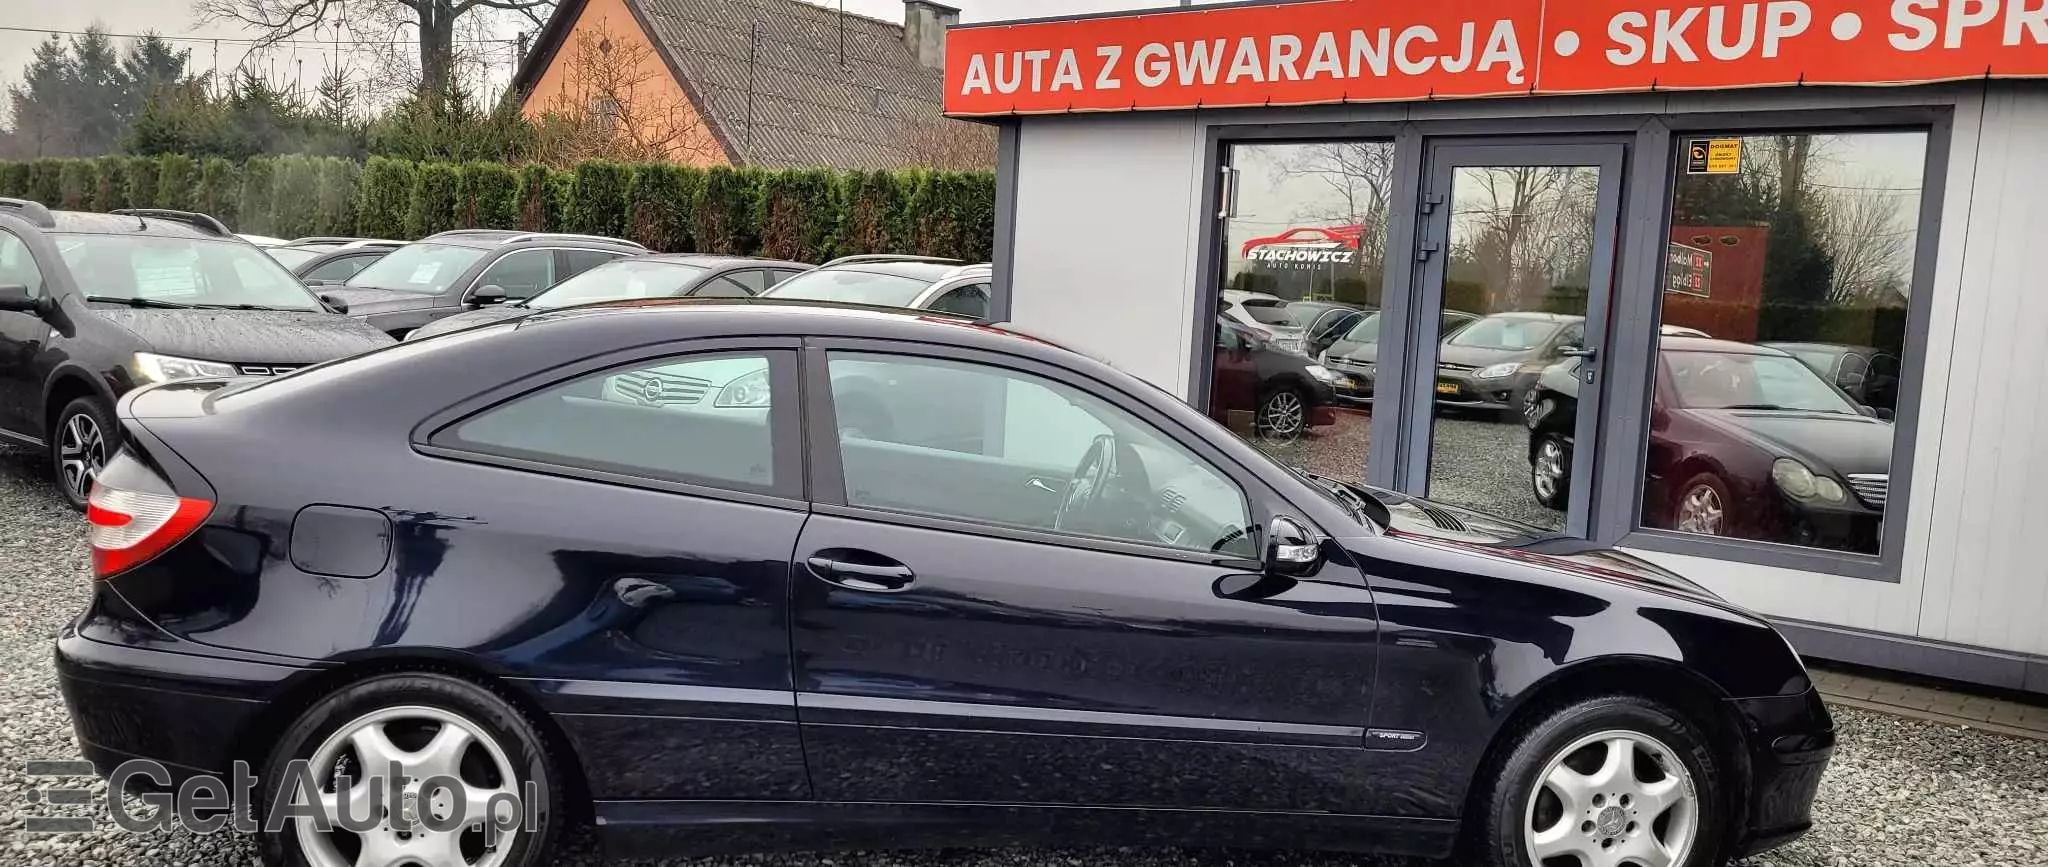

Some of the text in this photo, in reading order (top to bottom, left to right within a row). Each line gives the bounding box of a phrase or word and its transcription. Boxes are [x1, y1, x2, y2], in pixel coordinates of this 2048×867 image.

[961, 48, 1084, 95] AUTA
[1095, 46, 1122, 90] Z
[1134, 19, 1525, 87] GWARANCJĄ
[1605, 0, 1812, 66] SKUP
[1246, 248, 1353, 263] STACHOWICZ
